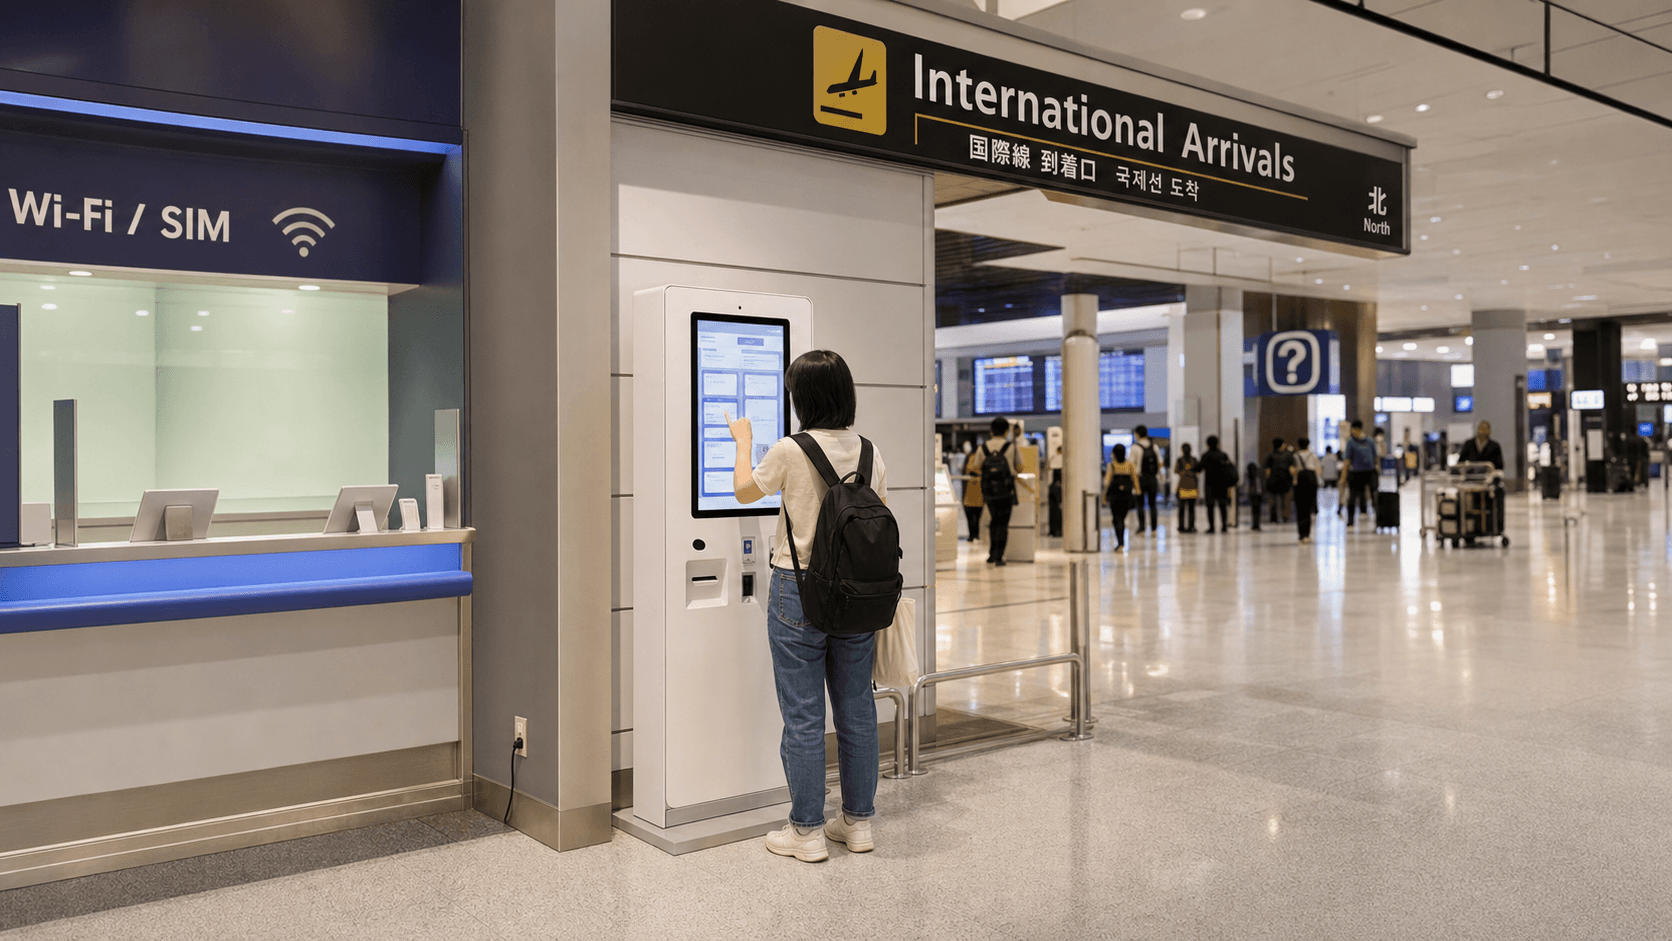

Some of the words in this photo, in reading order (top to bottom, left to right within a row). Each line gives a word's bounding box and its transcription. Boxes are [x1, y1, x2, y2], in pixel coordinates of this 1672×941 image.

[913, 52, 1164, 153] International
[1181, 121, 1296, 183] Arrivals
[969, 134, 1031, 170] 国際線
[1040, 149, 1097, 183] 到着口
[1115, 165, 1163, 195] 국제선
[1170, 177, 1200, 202] 도착
[1368, 186, 1387, 216] 北
[8, 187, 113, 233] Wi-Fi
[126, 203, 146, 236] /
[160, 205, 230, 243] SIM
[1363, 217, 1391, 236] North
